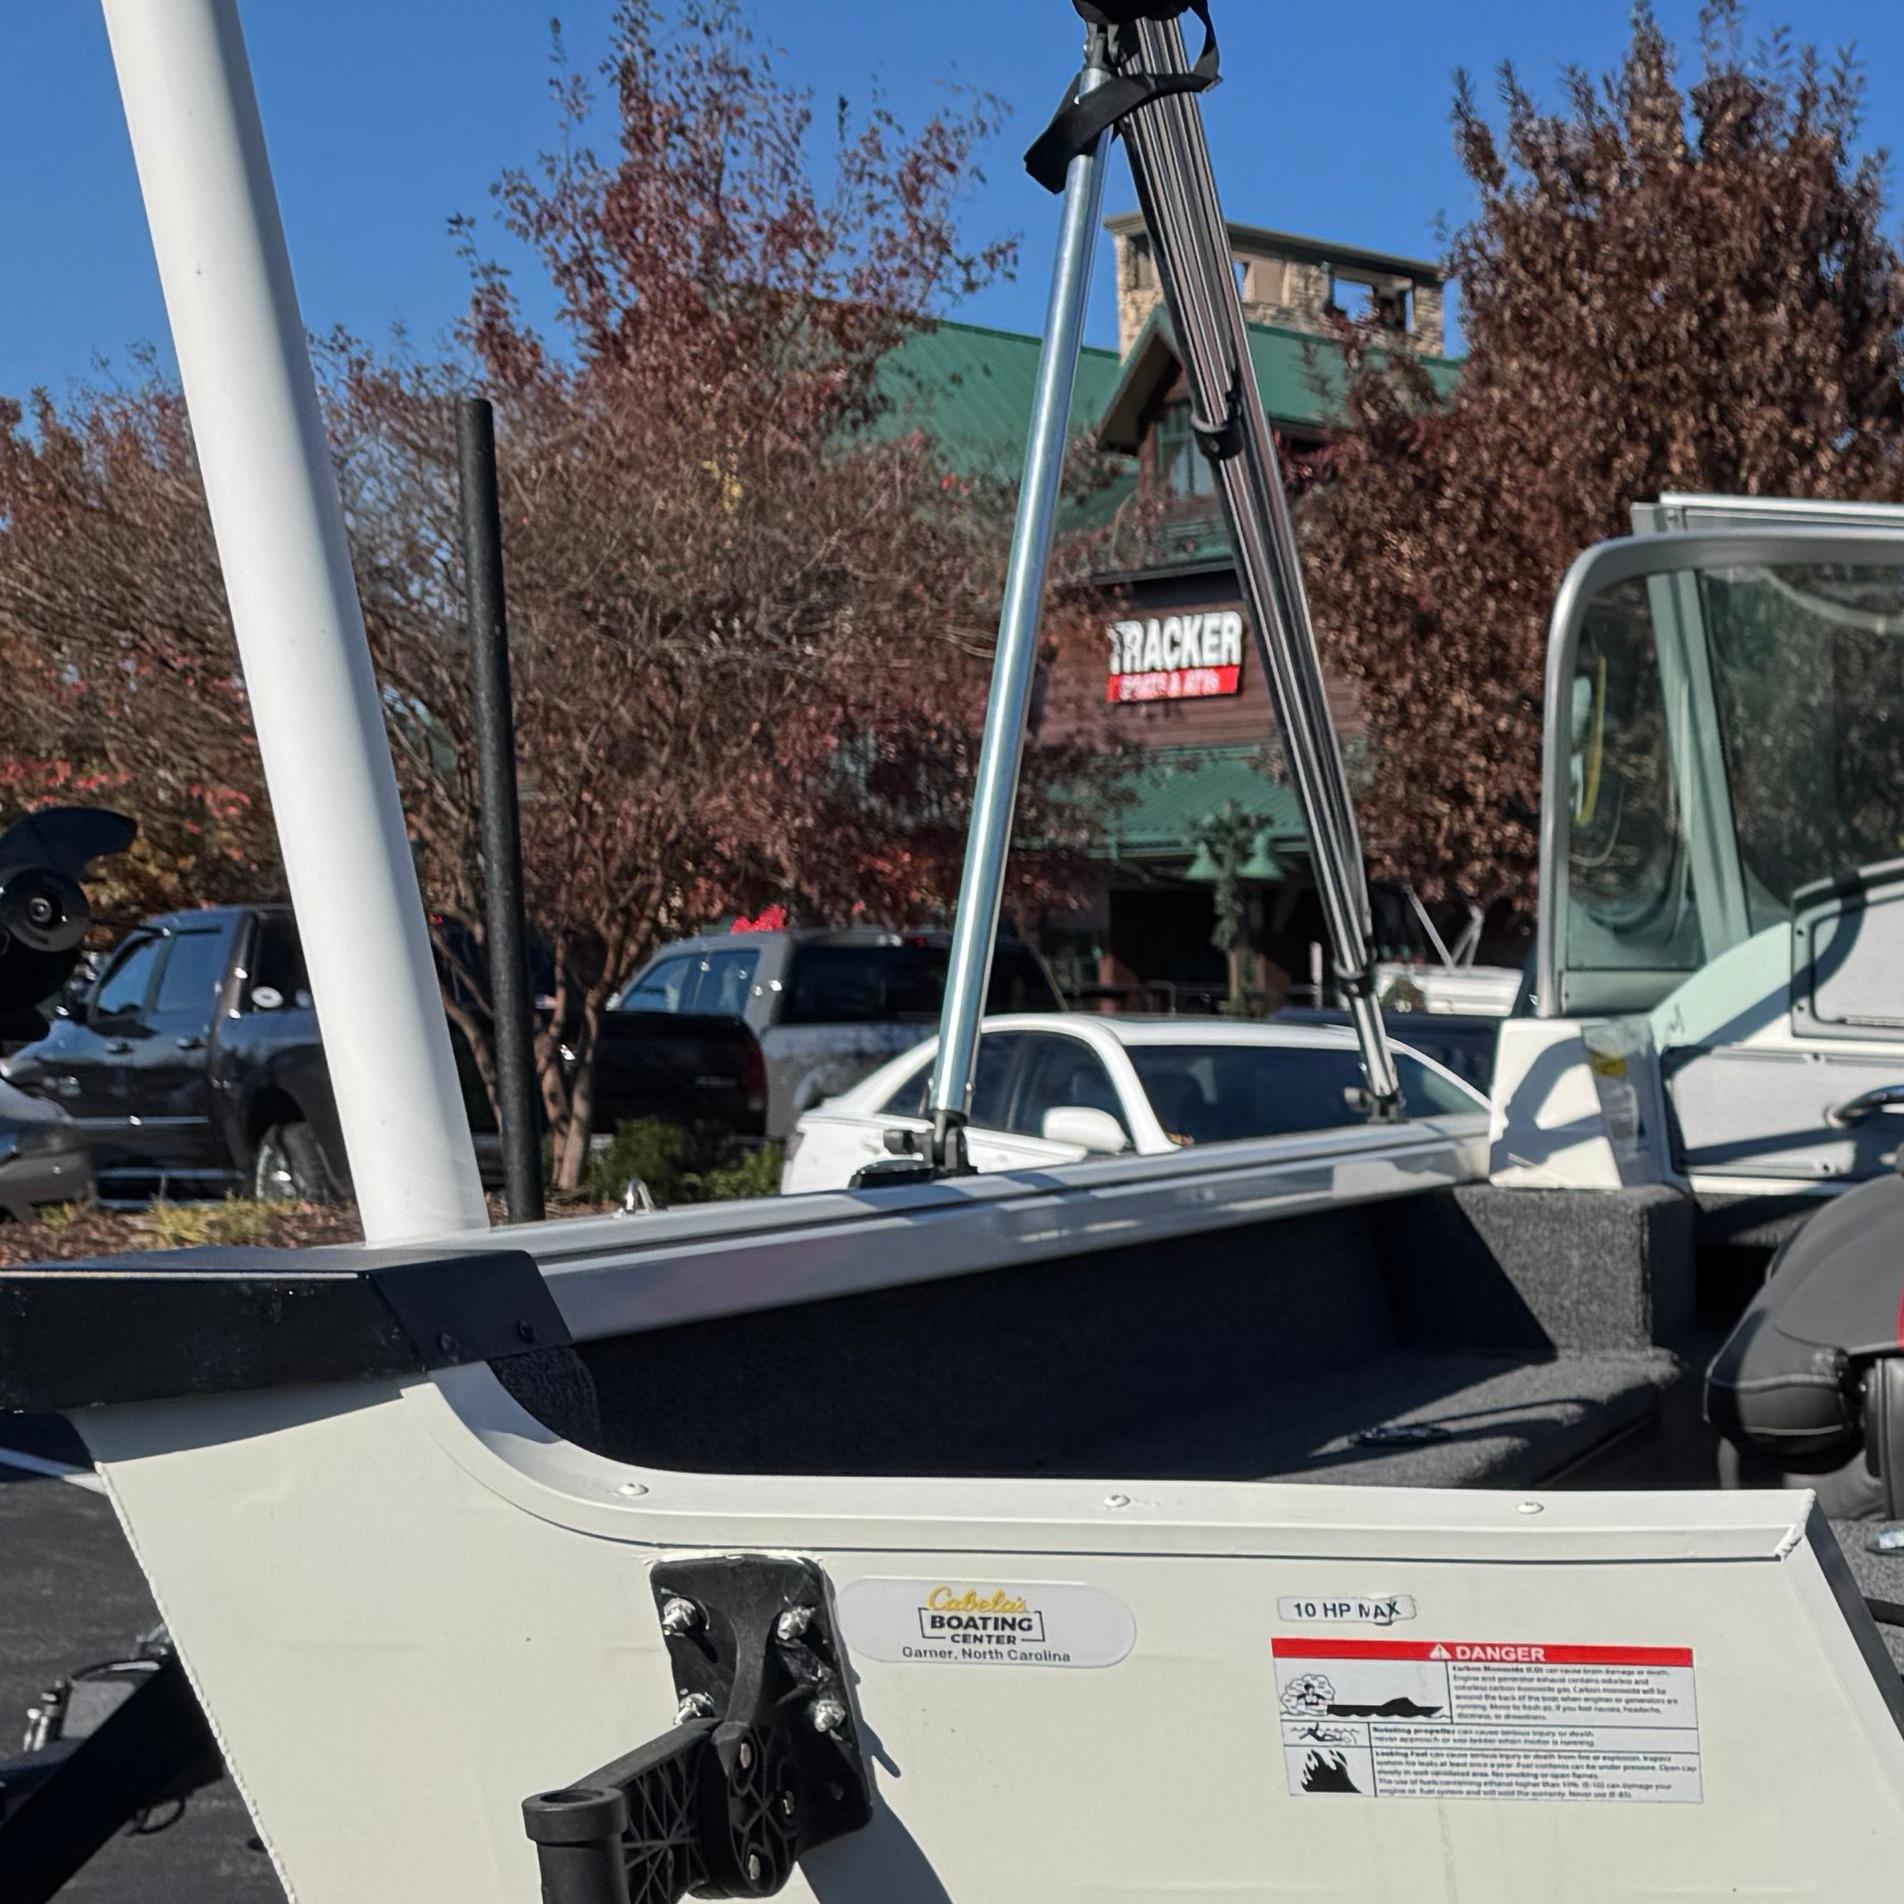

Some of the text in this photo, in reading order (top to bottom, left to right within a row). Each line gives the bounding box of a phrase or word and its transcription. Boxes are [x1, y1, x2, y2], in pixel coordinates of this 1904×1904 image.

[927, 1583, 1029, 1613] Cabela's
[1294, 1601, 1316, 1619] 10
[1322, 1601, 1351, 1619] HP
[930, 1614, 1034, 1632] BOATING
[950, 1633, 1017, 1646] CENTER
[902, 1646, 1072, 1663] Garner, North Carolina
[1456, 1645, 1545, 1663] DANGER
